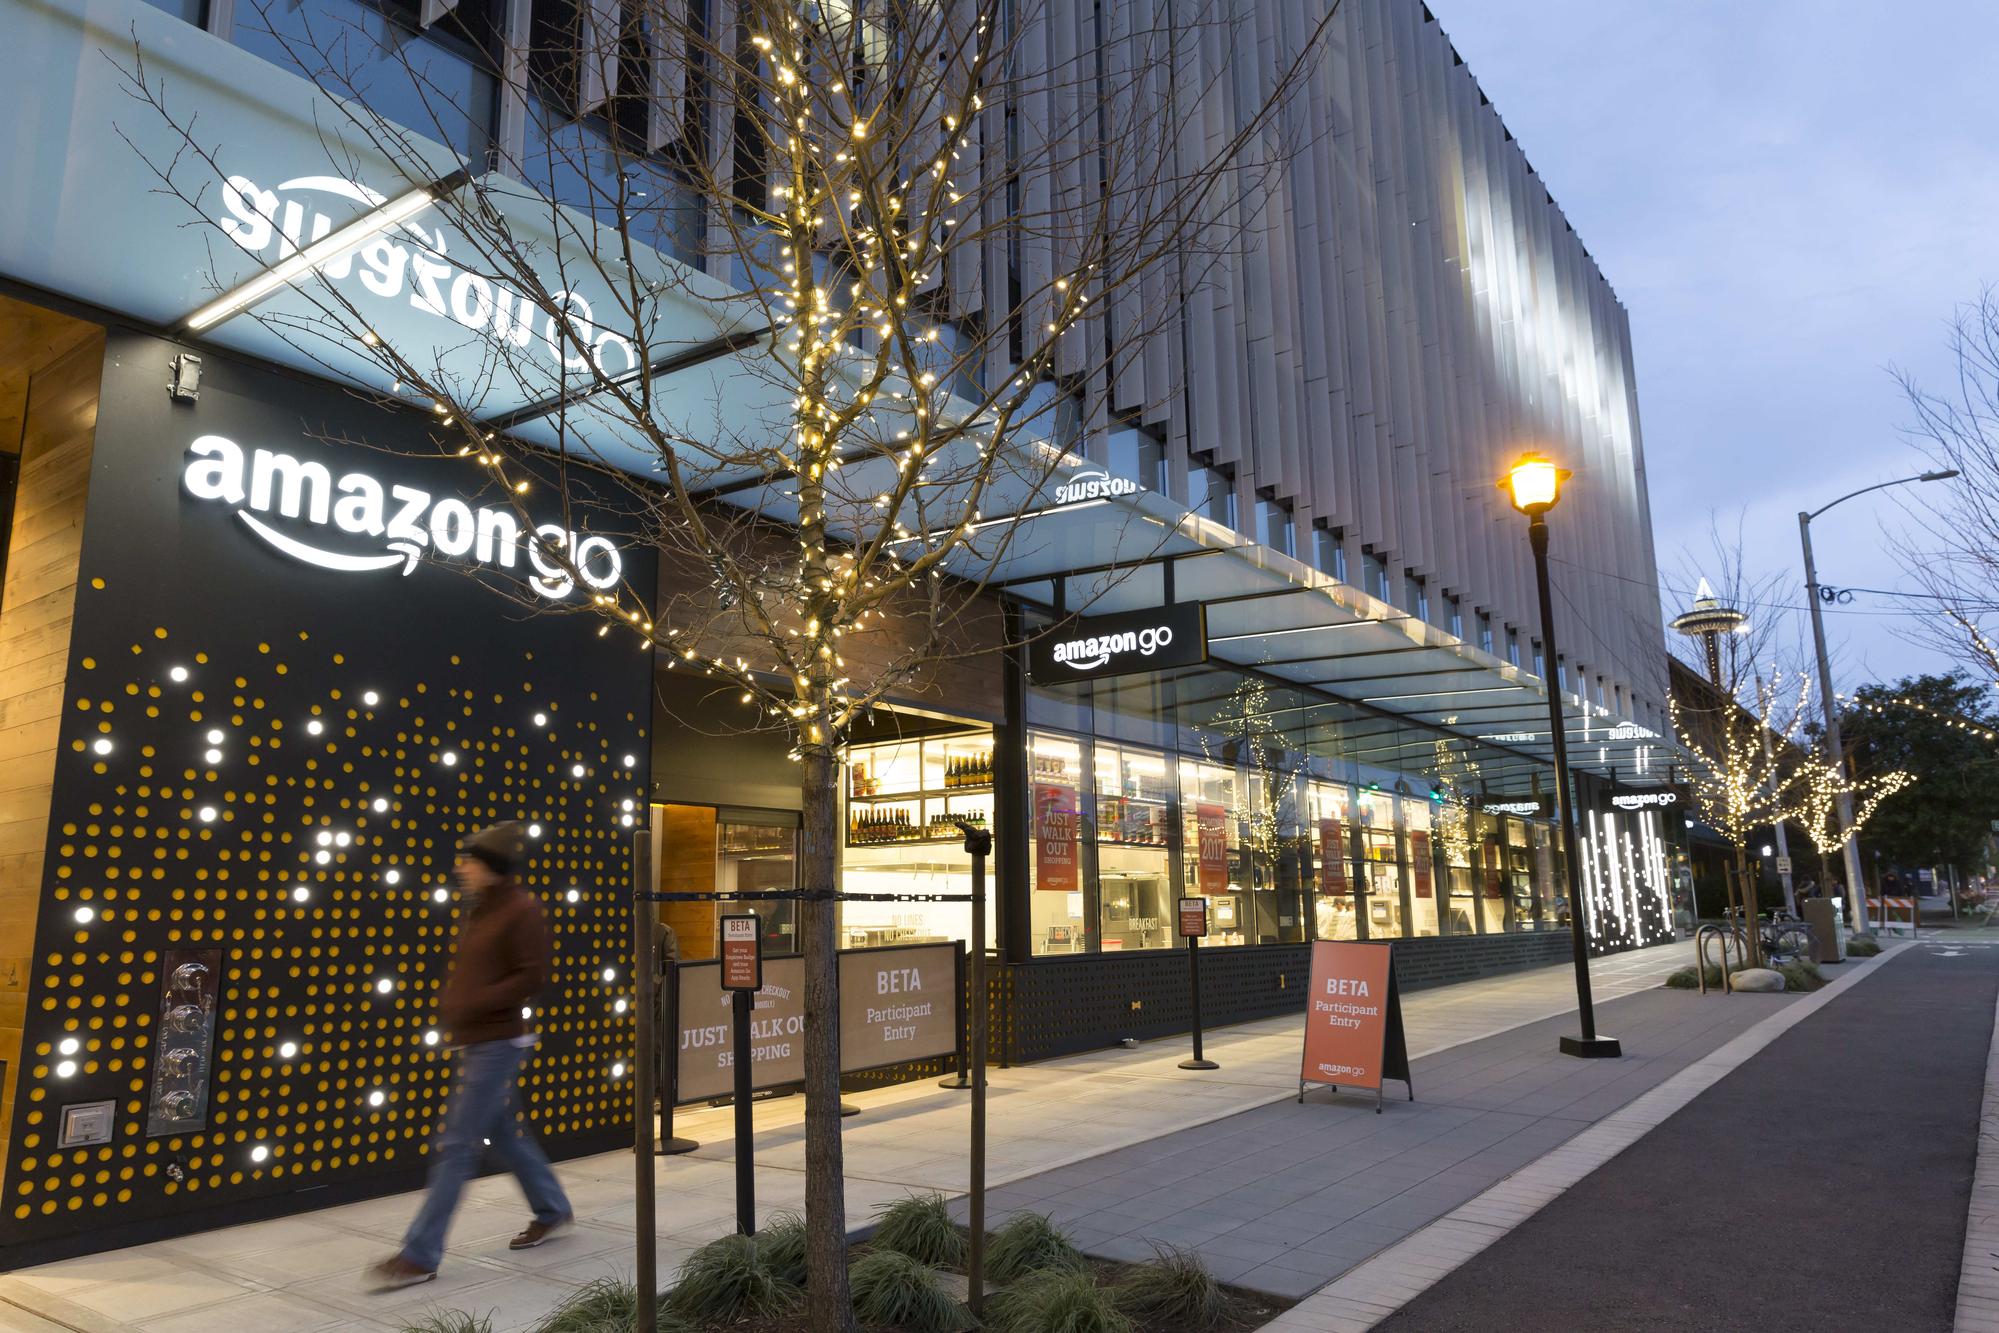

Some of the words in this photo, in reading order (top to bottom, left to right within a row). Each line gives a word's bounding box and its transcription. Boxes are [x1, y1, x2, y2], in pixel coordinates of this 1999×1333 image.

[184, 434, 516, 576] amazon
[528, 523, 622, 598] go
[1053, 631, 1137, 669] amazon
[1139, 626, 1173, 655] go
[1612, 794, 1657, 810] amazon
[1658, 793, 1676, 805] go
[1044, 813, 1070, 826] JUST
[1042, 827, 1072, 840] WALK
[1046, 843, 1069, 855] OUT
[1202, 838, 1224, 860] 2017
[731, 920, 750, 931] BETA
[877, 967, 921, 995] BETA
[1326, 978, 1369, 997] BETA
[866, 1002, 932, 1023] Participant
[1315, 1000, 1378, 1016] Participant
[1329, 1014, 1361, 1029] Entry
[681, 1025, 727, 1050] JUST
[751, 1018, 783, 1040] ALK
[883, 1026, 916, 1041] Entry
[718, 1043, 791, 1067] SHPPING
[1318, 1063, 1351, 1076] amazon
[1352, 1067, 1365, 1077] go
